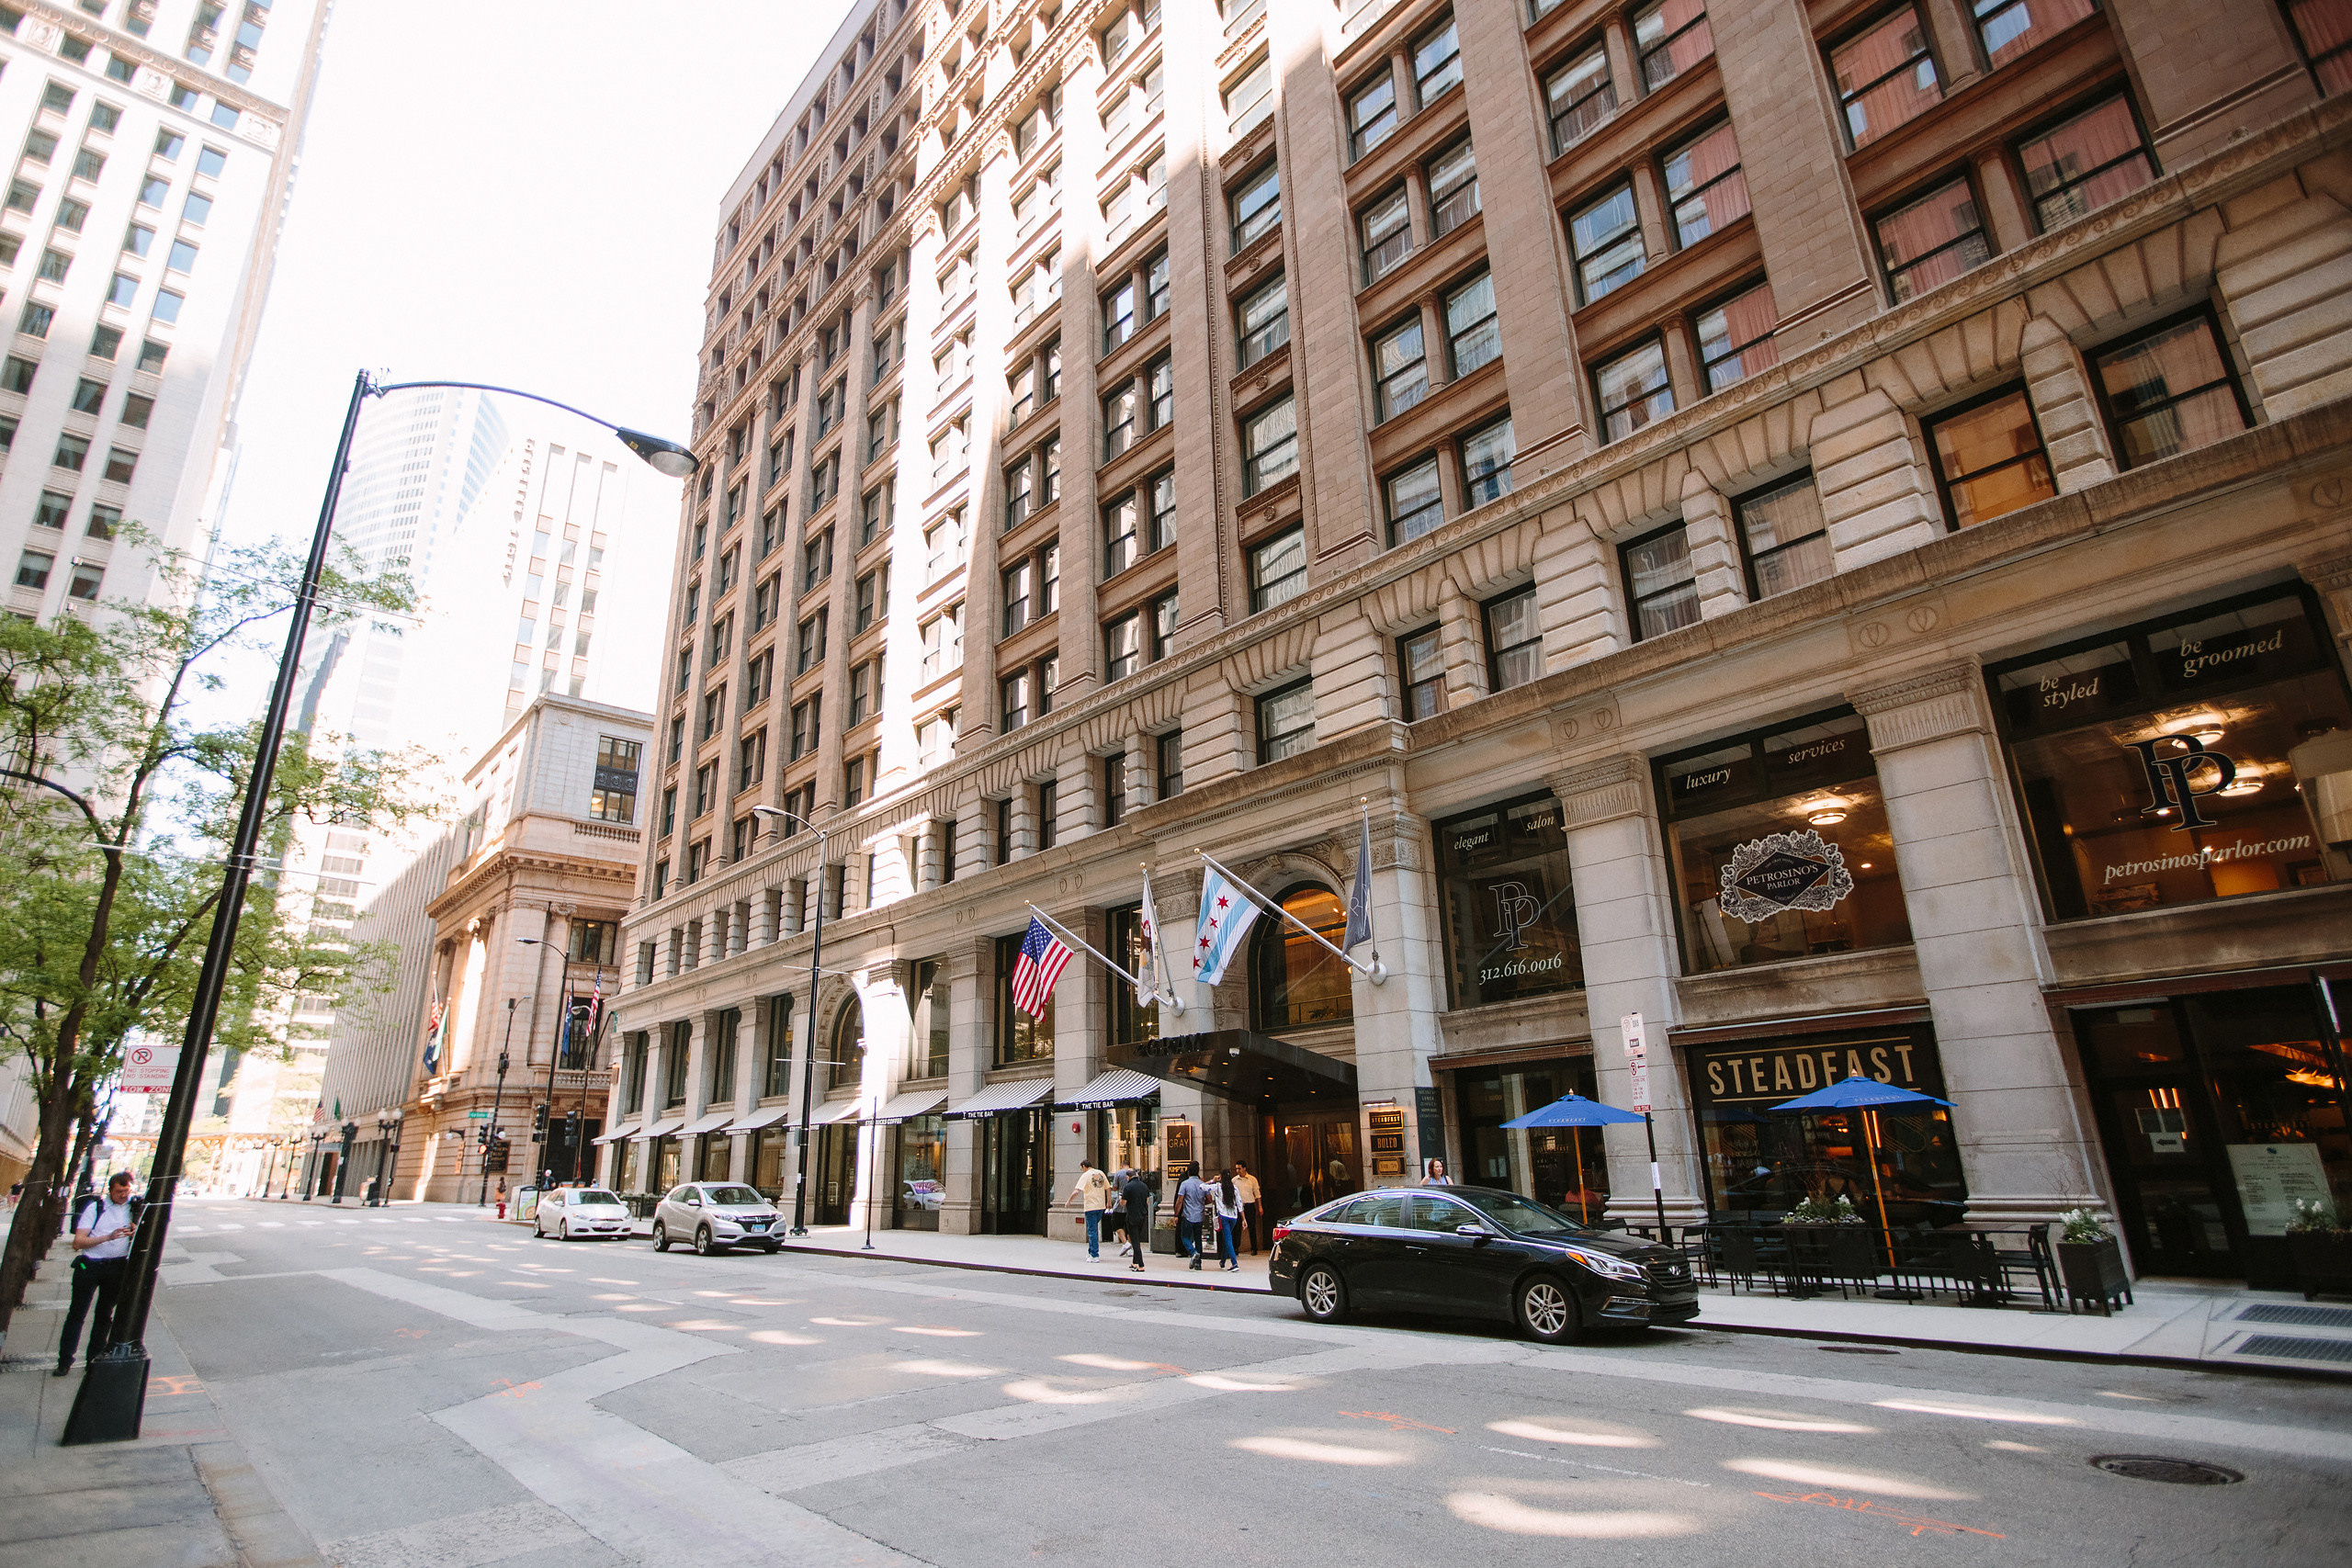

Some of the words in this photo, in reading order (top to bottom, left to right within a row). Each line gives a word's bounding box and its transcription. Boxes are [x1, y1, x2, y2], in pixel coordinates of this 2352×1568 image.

[2179, 637, 2203, 658] be
[2183, 629, 2284, 679] groomed
[2039, 674, 2060, 694] be
[2042, 677, 2100, 710] styled
[1685, 767, 1731, 790] luxury
[1787, 739, 1846, 764] services
[1453, 831, 1489, 851] elegant
[1526, 815, 1555, 831] salon
[1746, 864, 1819, 886] PETROSINO'S
[2103, 833, 2312, 885] petrosinosparlor.com
[1767, 877, 1801, 890] PARLOR
[1479, 952, 1562, 986] 312.616.0016
[1707, 1043, 1914, 1096] STEADFAST
[1169, 1139, 1189, 1148] GRAY
[1377, 1137, 1397, 1148] BOLEO
